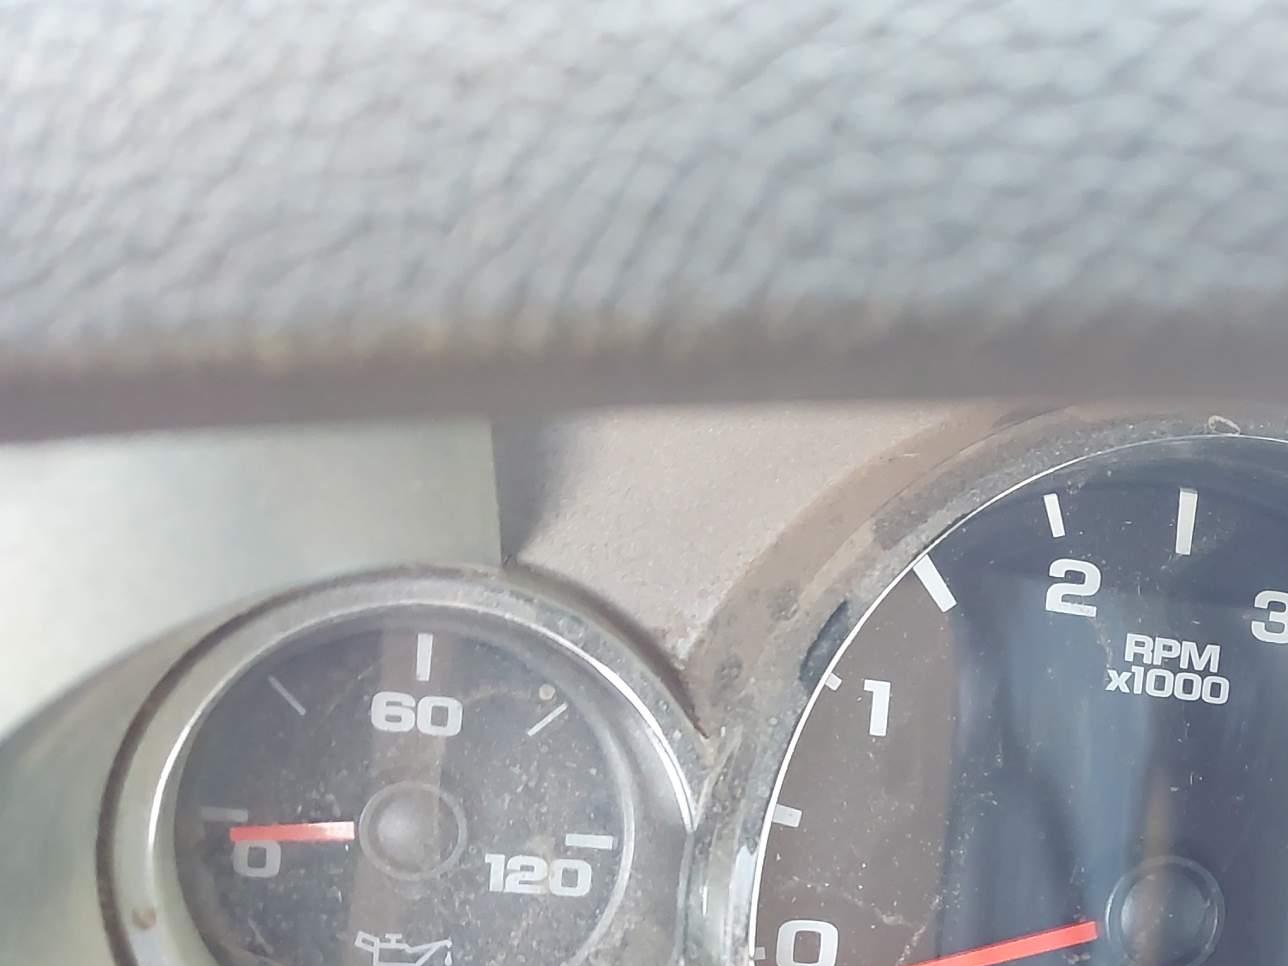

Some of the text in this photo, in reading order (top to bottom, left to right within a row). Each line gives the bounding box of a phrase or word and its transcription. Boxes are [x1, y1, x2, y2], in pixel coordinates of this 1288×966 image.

[1045, 558, 1101, 617] 2
[1125, 632, 1221, 674] RPM
[864, 680, 890, 736] 1
[1105, 666, 1231, 705] x1000
[370, 692, 463, 737] 60
[232, 838, 282, 878] 0
[485, 853, 593, 898] 120
